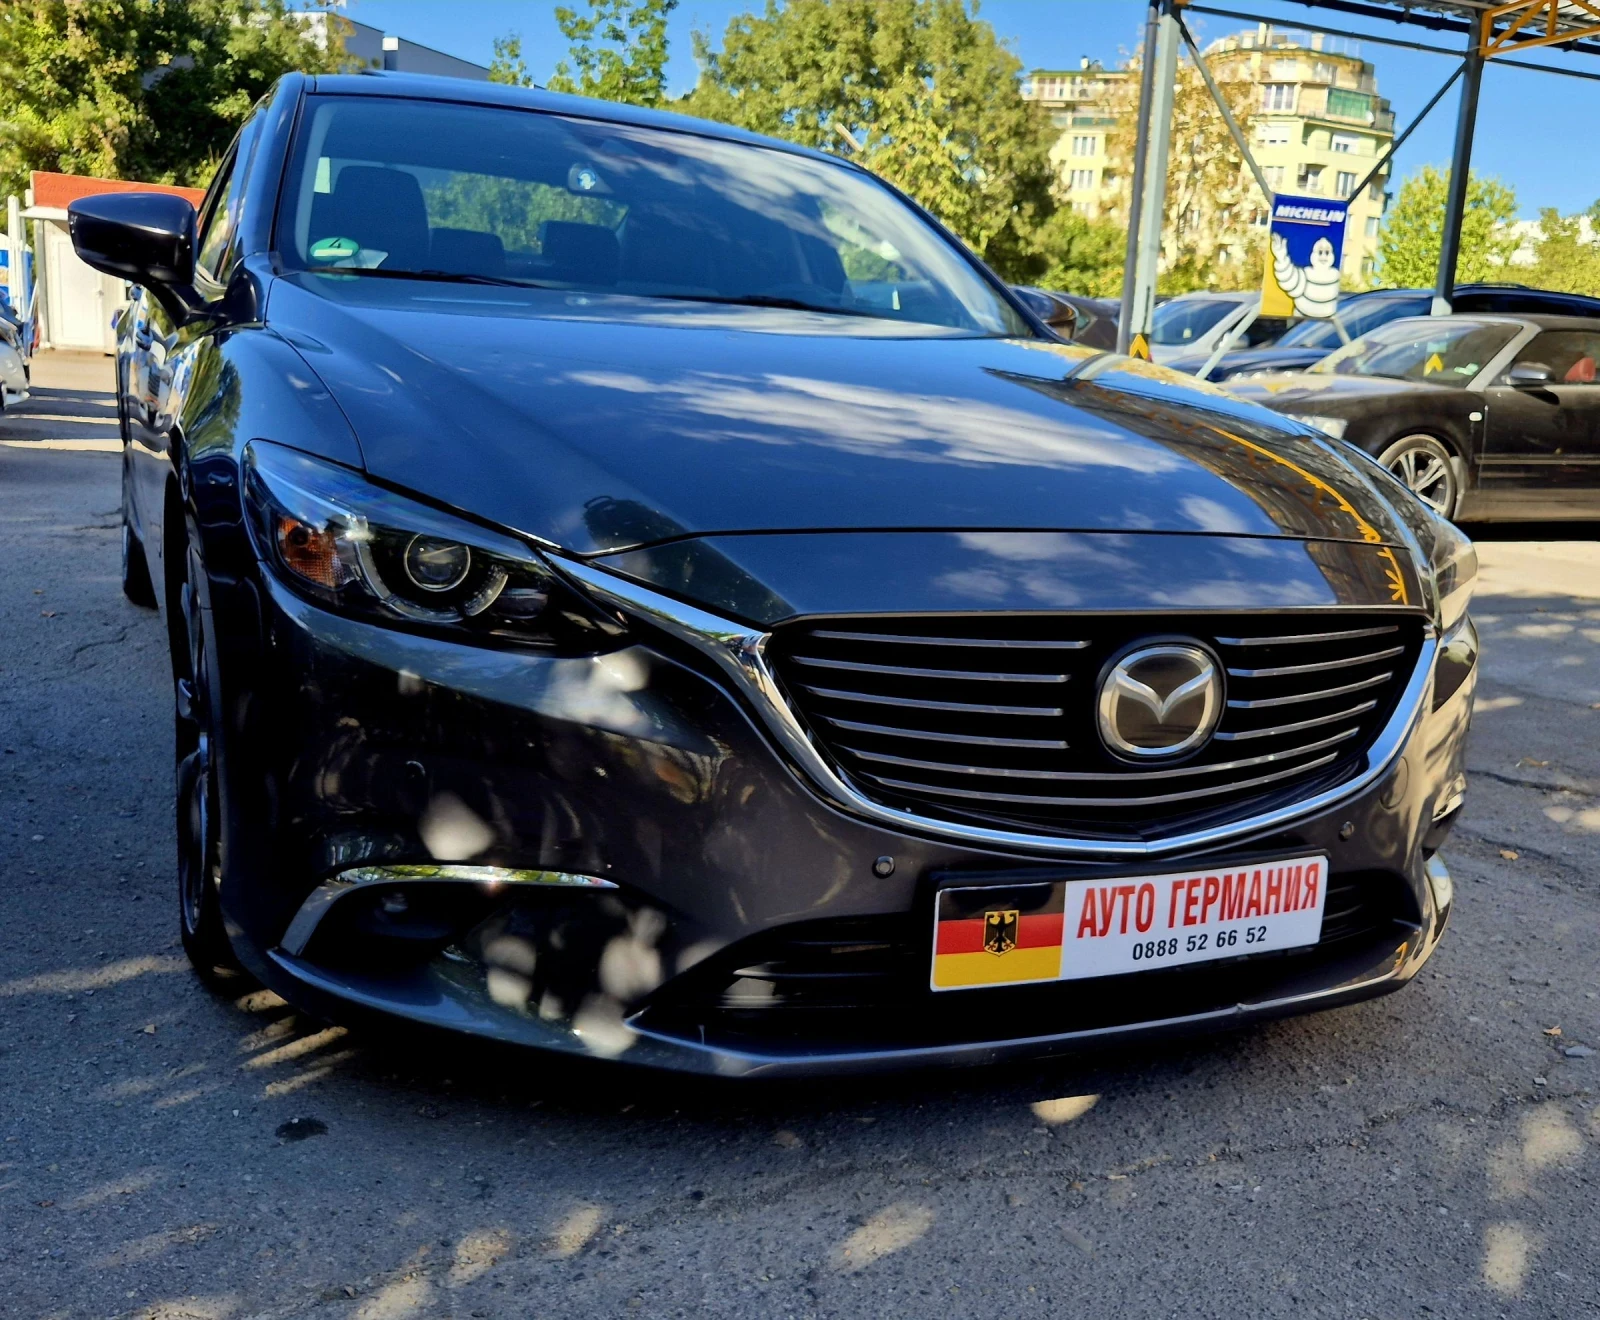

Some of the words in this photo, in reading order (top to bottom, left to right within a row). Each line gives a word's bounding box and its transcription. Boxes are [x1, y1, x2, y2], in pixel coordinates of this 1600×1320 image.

[1275, 205, 1346, 222] MICHELIN
[1076, 883, 1156, 939] АУТО
[1167, 863, 1320, 928] ГЕРМАНИЯ
[1132, 938, 1178, 961] 0888
[1186, 934, 1208, 952] 52
[1216, 930, 1238, 948] 66
[1245, 926, 1268, 944] 52
